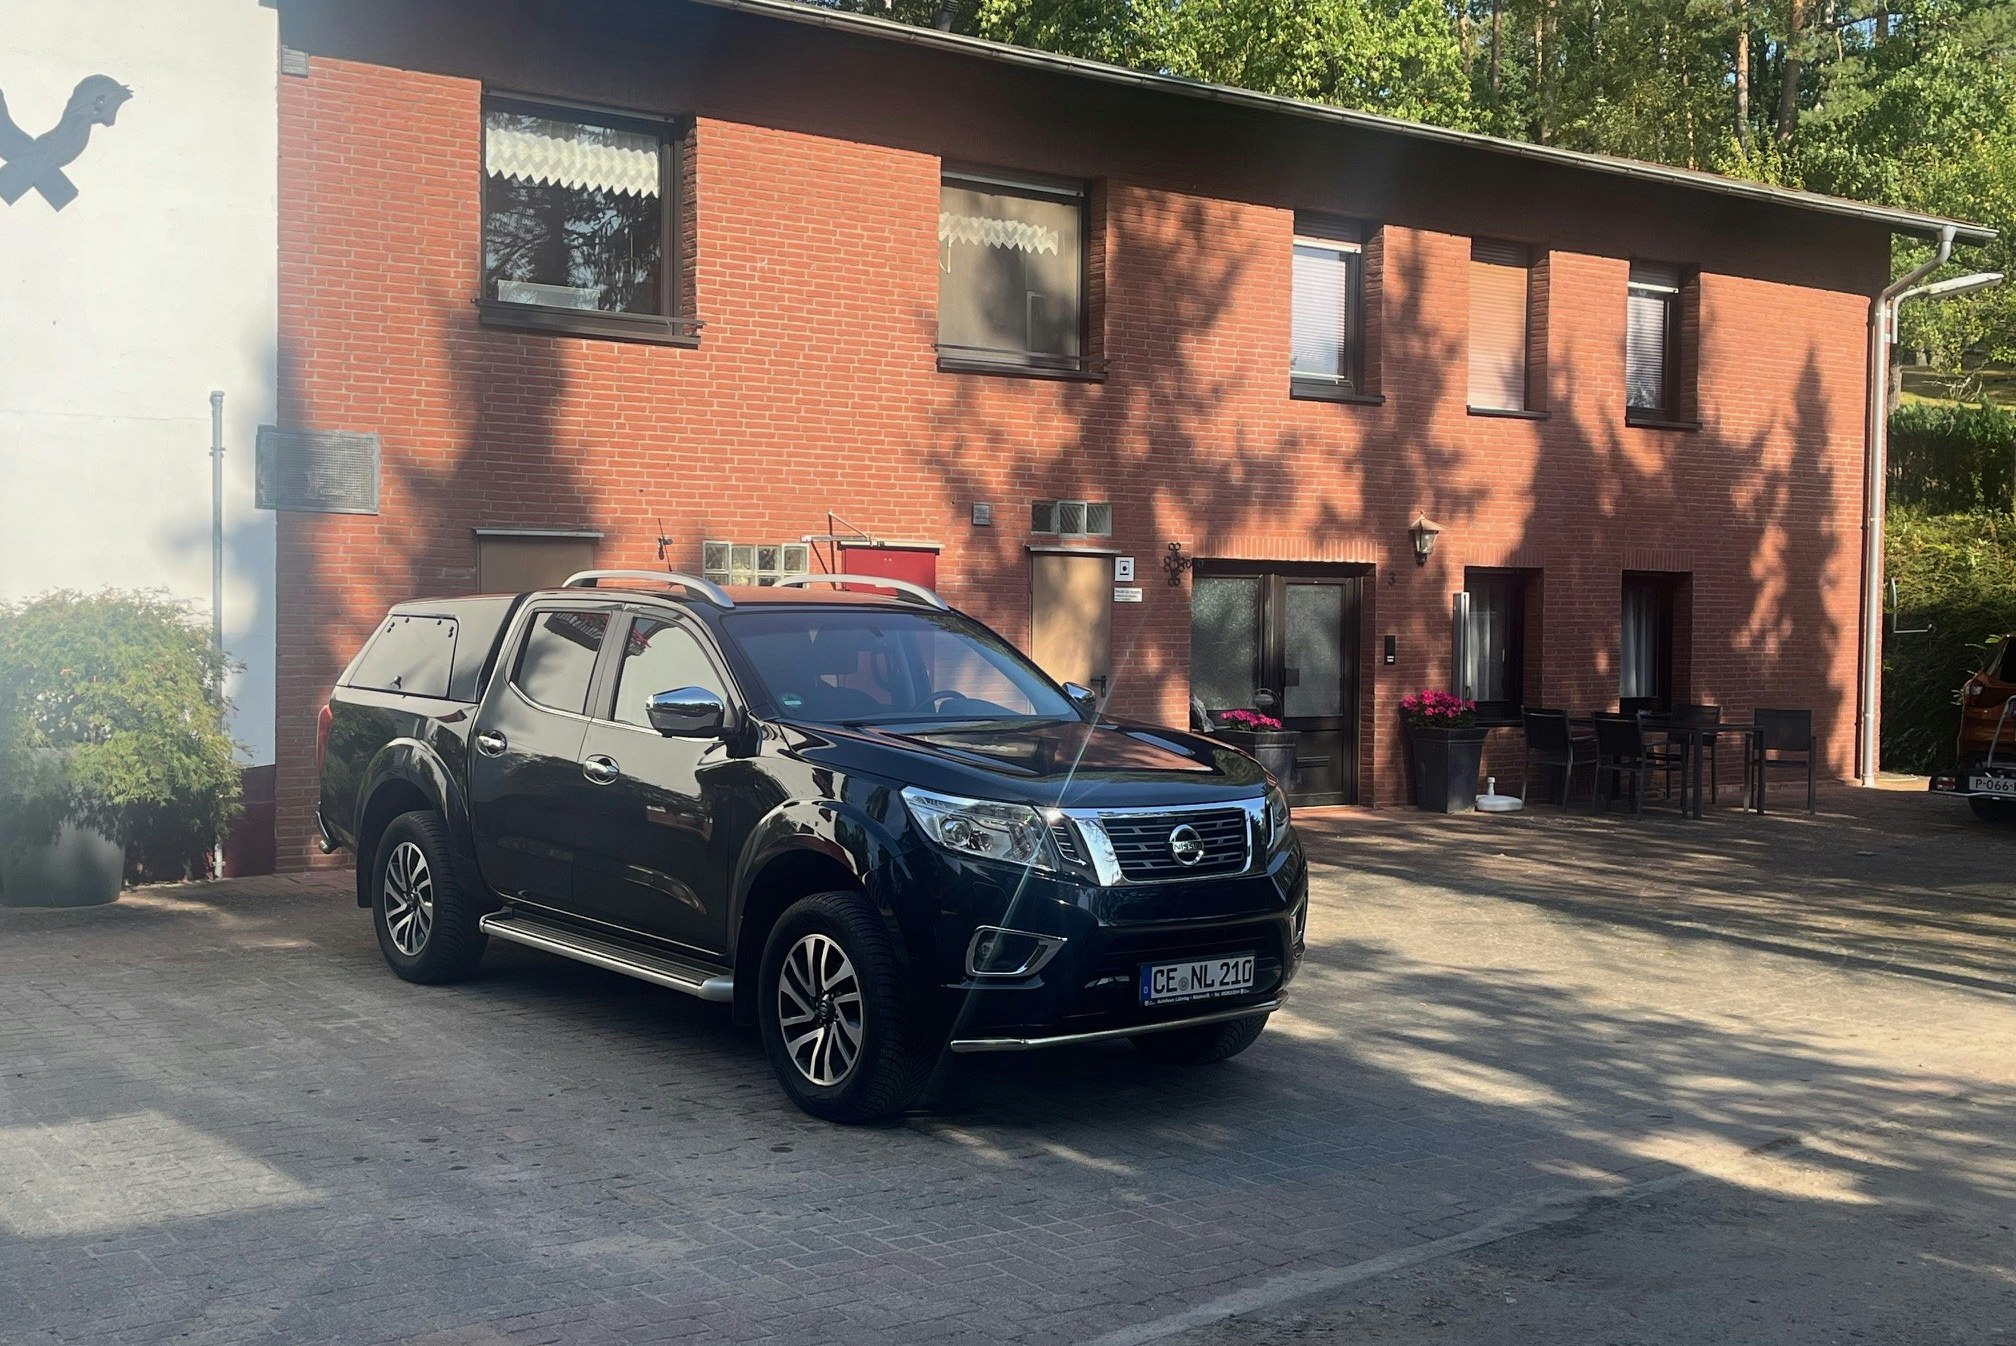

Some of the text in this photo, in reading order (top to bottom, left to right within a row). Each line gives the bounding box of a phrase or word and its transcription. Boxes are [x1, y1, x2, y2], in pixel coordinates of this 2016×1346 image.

[1388, 572, 1395, 586] 3
[1976, 779, 2016, 792] P-066-
[1153, 960, 1252, 994] CE NL 210
[1143, 986, 1148, 994] D
